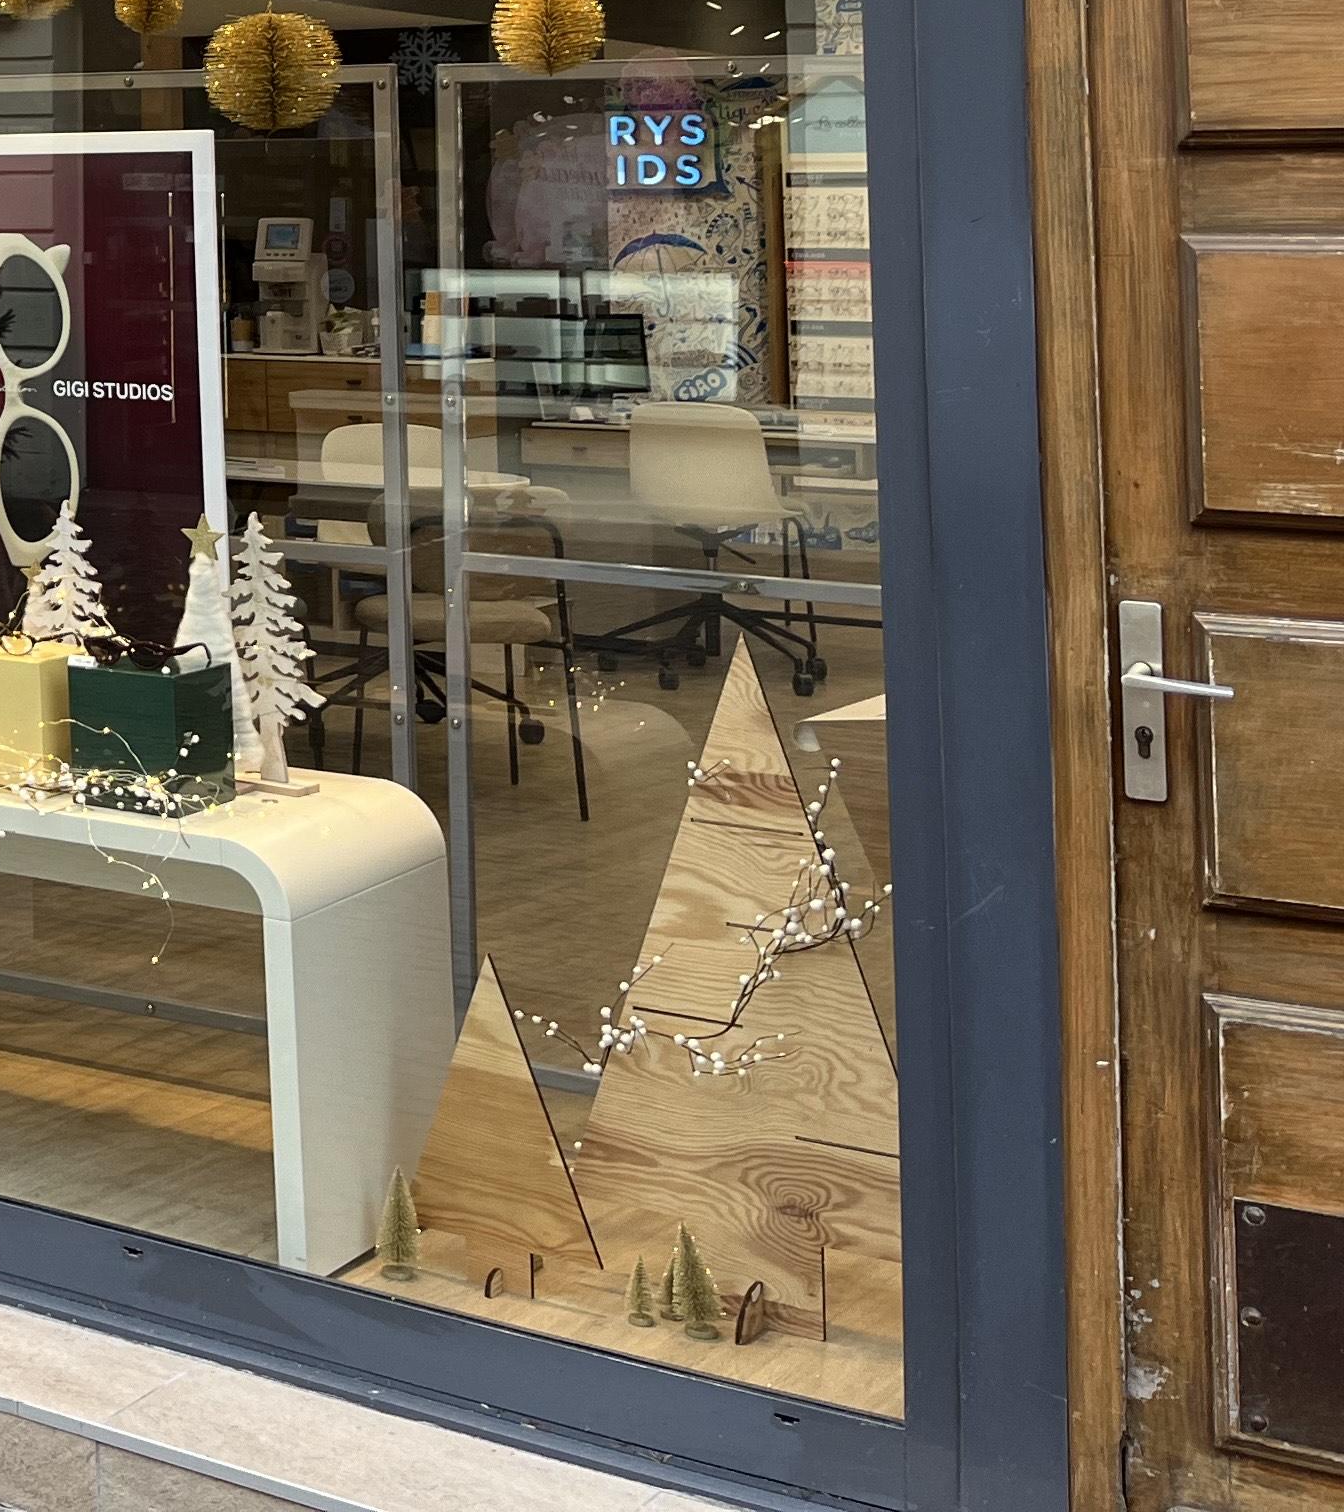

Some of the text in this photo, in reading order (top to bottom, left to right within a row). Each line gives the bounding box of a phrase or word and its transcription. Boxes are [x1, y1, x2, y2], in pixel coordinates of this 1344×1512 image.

[609, 113, 706, 147] RYS
[616, 153, 702, 187] IDS
[53, 380, 174, 402] GIGI STUDIOS
